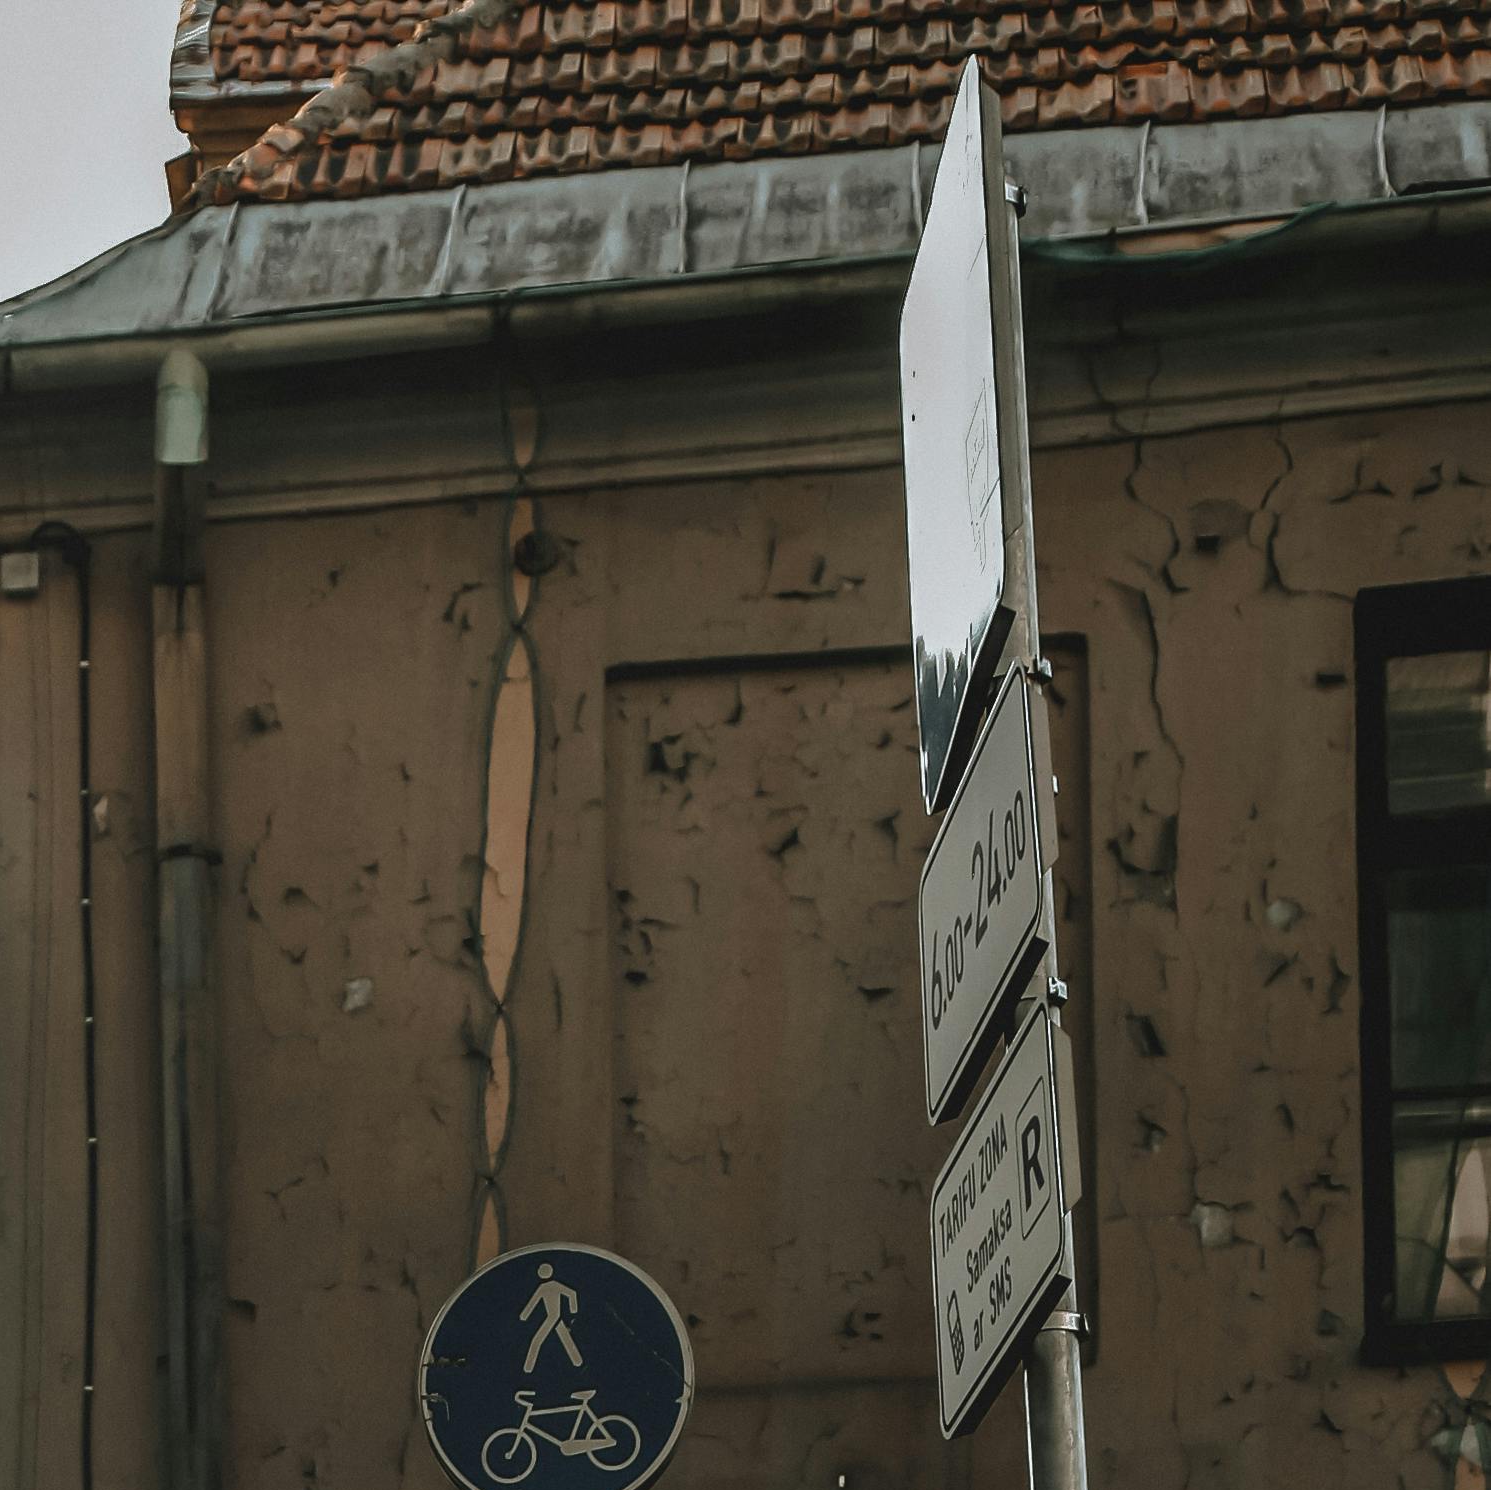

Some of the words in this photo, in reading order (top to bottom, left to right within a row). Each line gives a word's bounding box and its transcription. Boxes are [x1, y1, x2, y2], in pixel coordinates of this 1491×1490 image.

[931, 788, 1026, 1031] 6.00-24.00
[939, 1161, 977, 1258] TARIFU
[977, 1112, 1008, 1194] ZONA
[1020, 1114, 1045, 1213] R
[966, 1198, 1013, 1294] Samaksa
[973, 1309, 984, 1352] ar
[989, 1255, 1012, 1326] SMS
